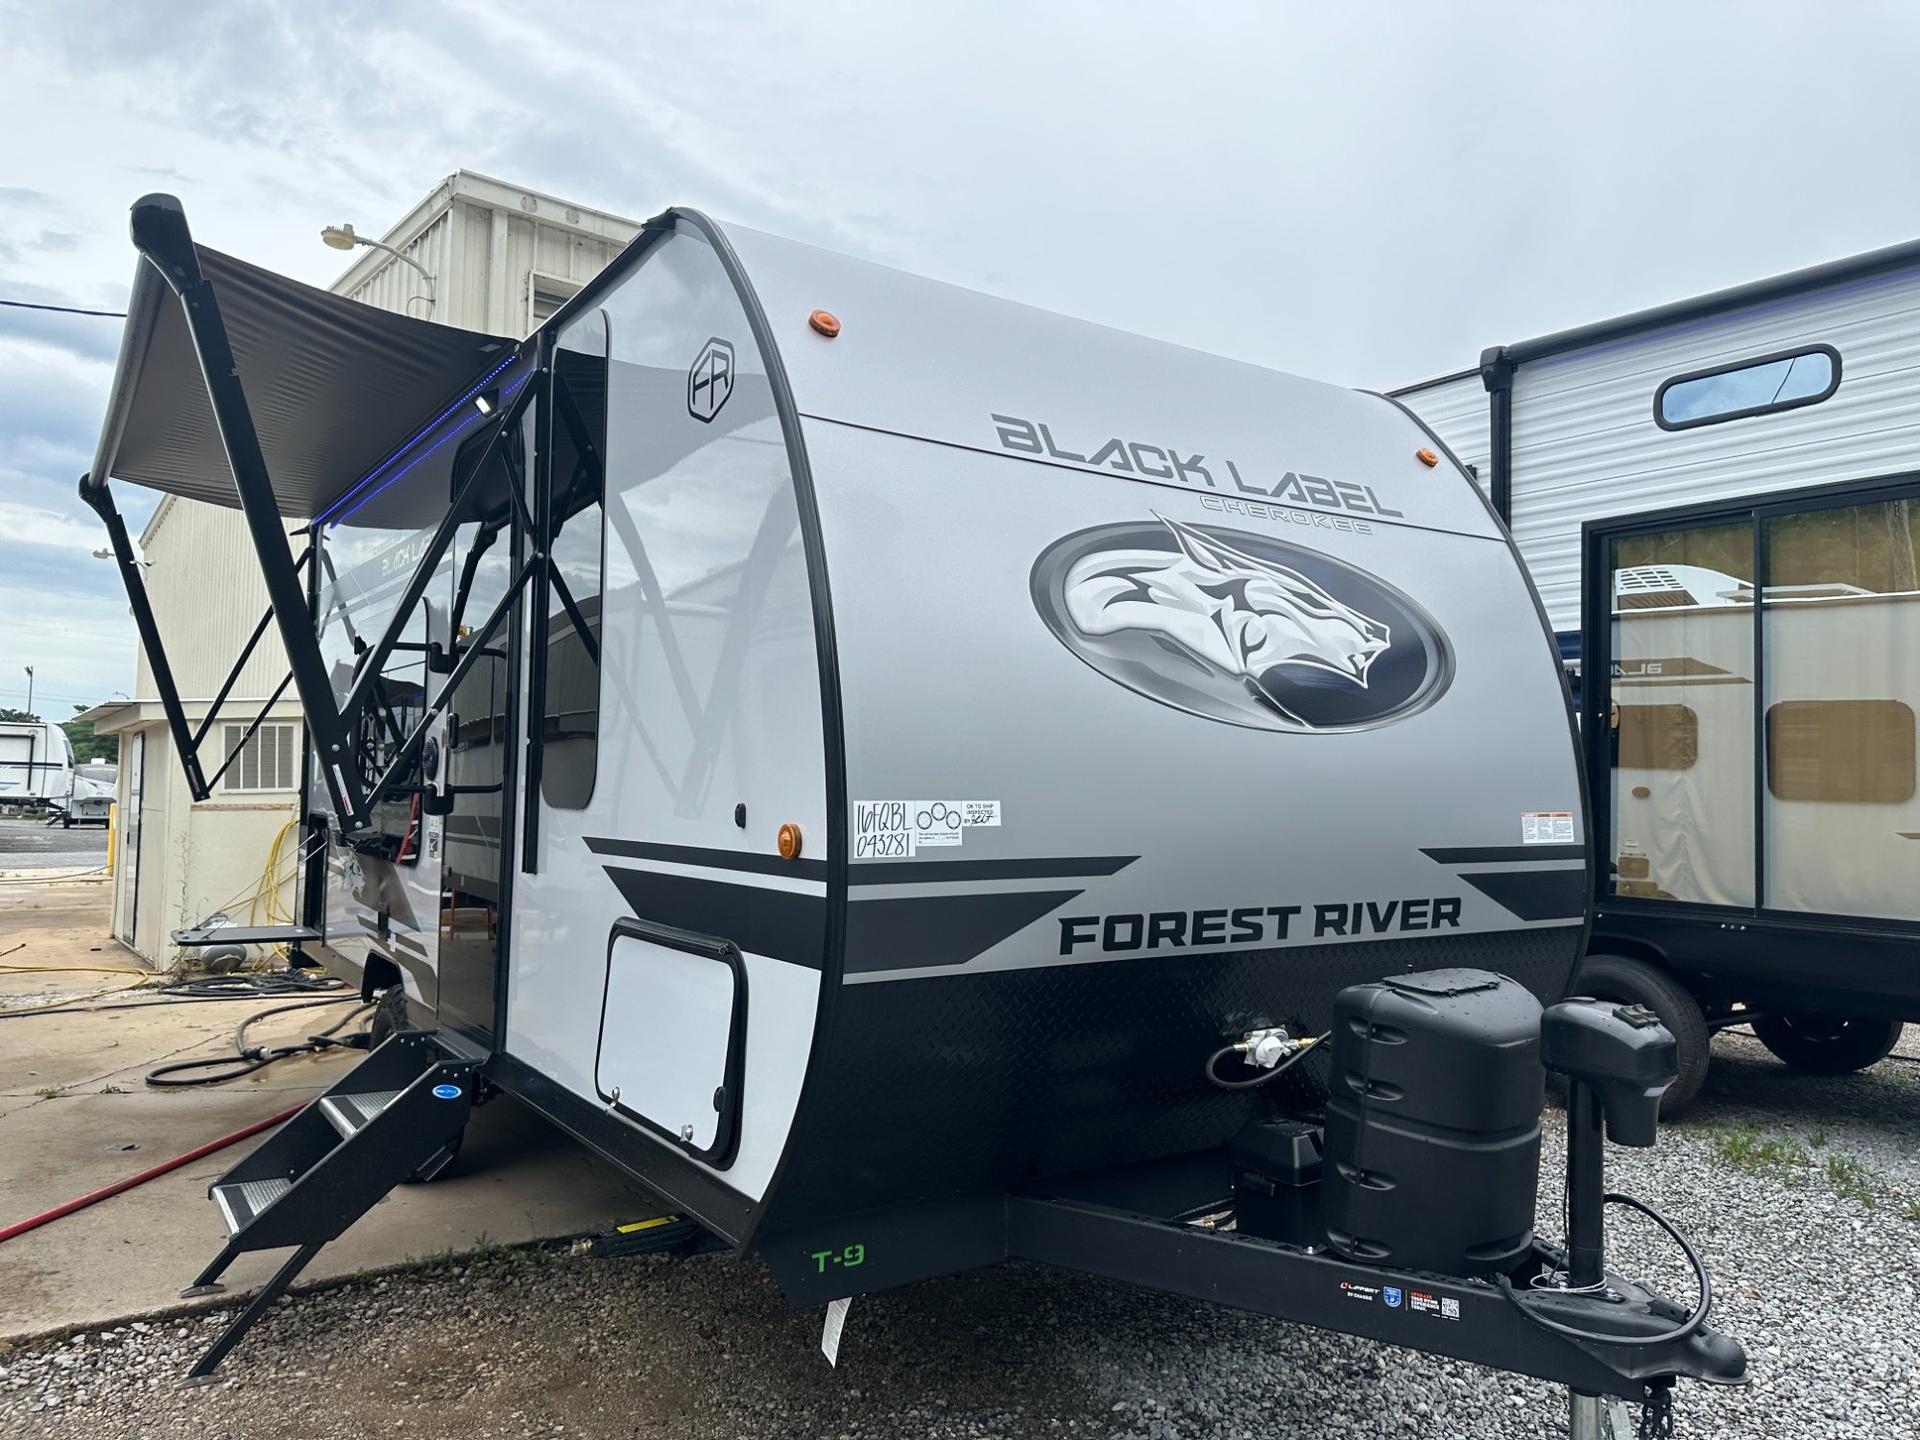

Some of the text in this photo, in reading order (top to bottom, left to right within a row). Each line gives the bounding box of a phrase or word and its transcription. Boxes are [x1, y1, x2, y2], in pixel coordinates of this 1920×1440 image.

[990, 412, 1405, 518] BLACK LABEL
[1199, 495, 1374, 535] CHEROKEE
[857, 802, 913, 835] 16FQBL
[856, 833, 910, 858] 043281
[1057, 896, 1462, 956] FOREST RIVER
[811, 1243, 865, 1273] T-9
